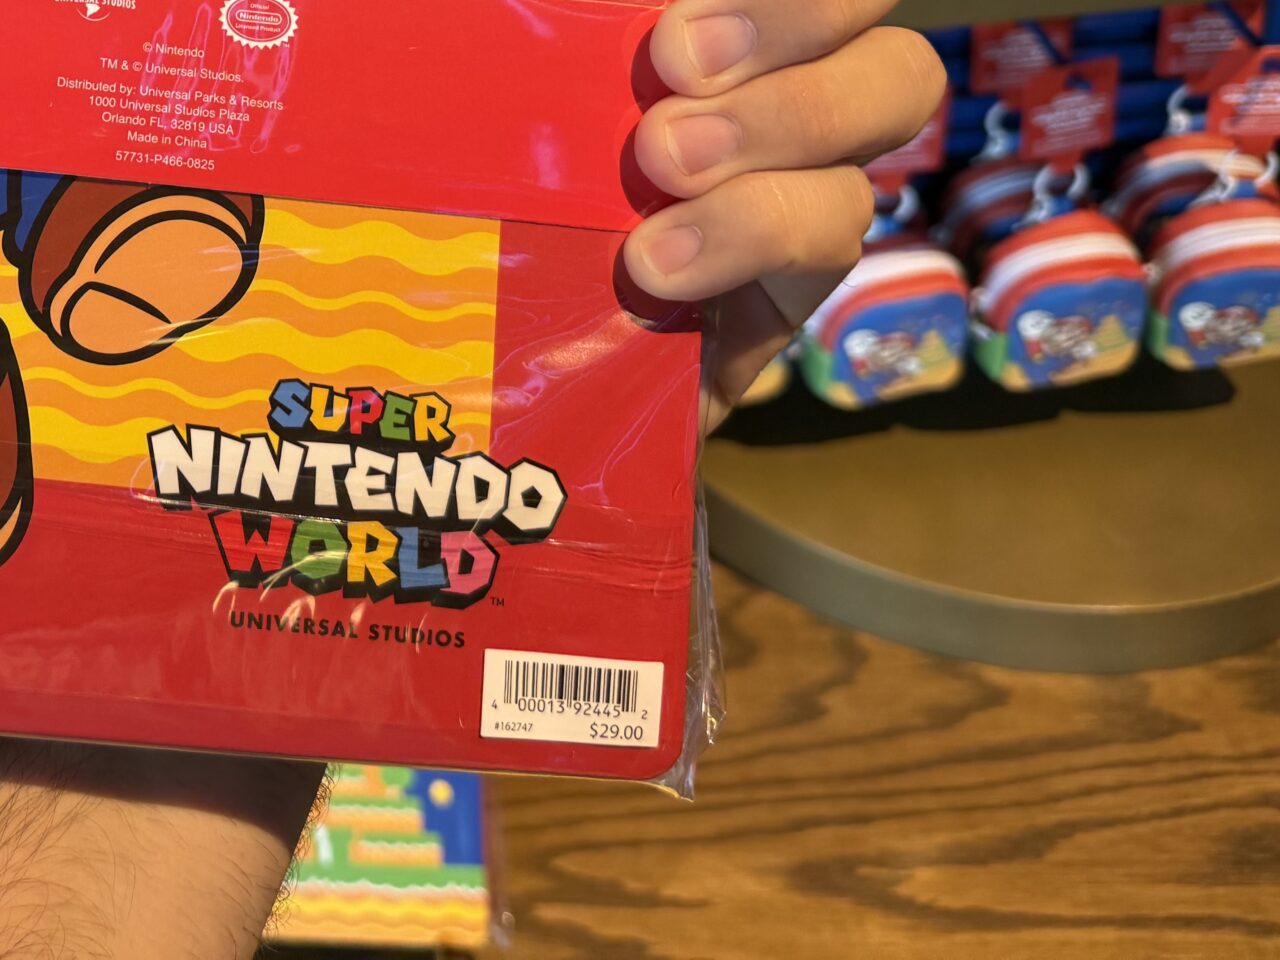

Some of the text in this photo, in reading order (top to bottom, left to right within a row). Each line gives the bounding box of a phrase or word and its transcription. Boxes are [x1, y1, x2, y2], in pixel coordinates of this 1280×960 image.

[239, 12, 279, 23] Nintendo
[155, 42, 205, 58] Nintendo
[100, 57, 118, 70] TM
[121, 59, 129, 71] &
[145, 62, 197, 78] Universal
[200, 67, 244, 83] Studios.
[57, 76, 284, 111] Distributed by: Universal Parks & Resorts
[89, 95, 250, 122] 1000 Universal Studios Plaza
[101, 111, 234, 136] Orlando FL, 32819 USA
[127, 130, 207, 149] Made in China
[115, 150, 215, 170] 57731-P466-0825
[269, 378, 455, 442] SUPER
[148, 425, 568, 538] NINTENDO
[213, 513, 499, 607] WORLD
[230, 610, 466, 649] UNIVERSAL STUDIOS
[573, 701, 621, 718] 92445
[589, 721, 644, 740] $29.00
